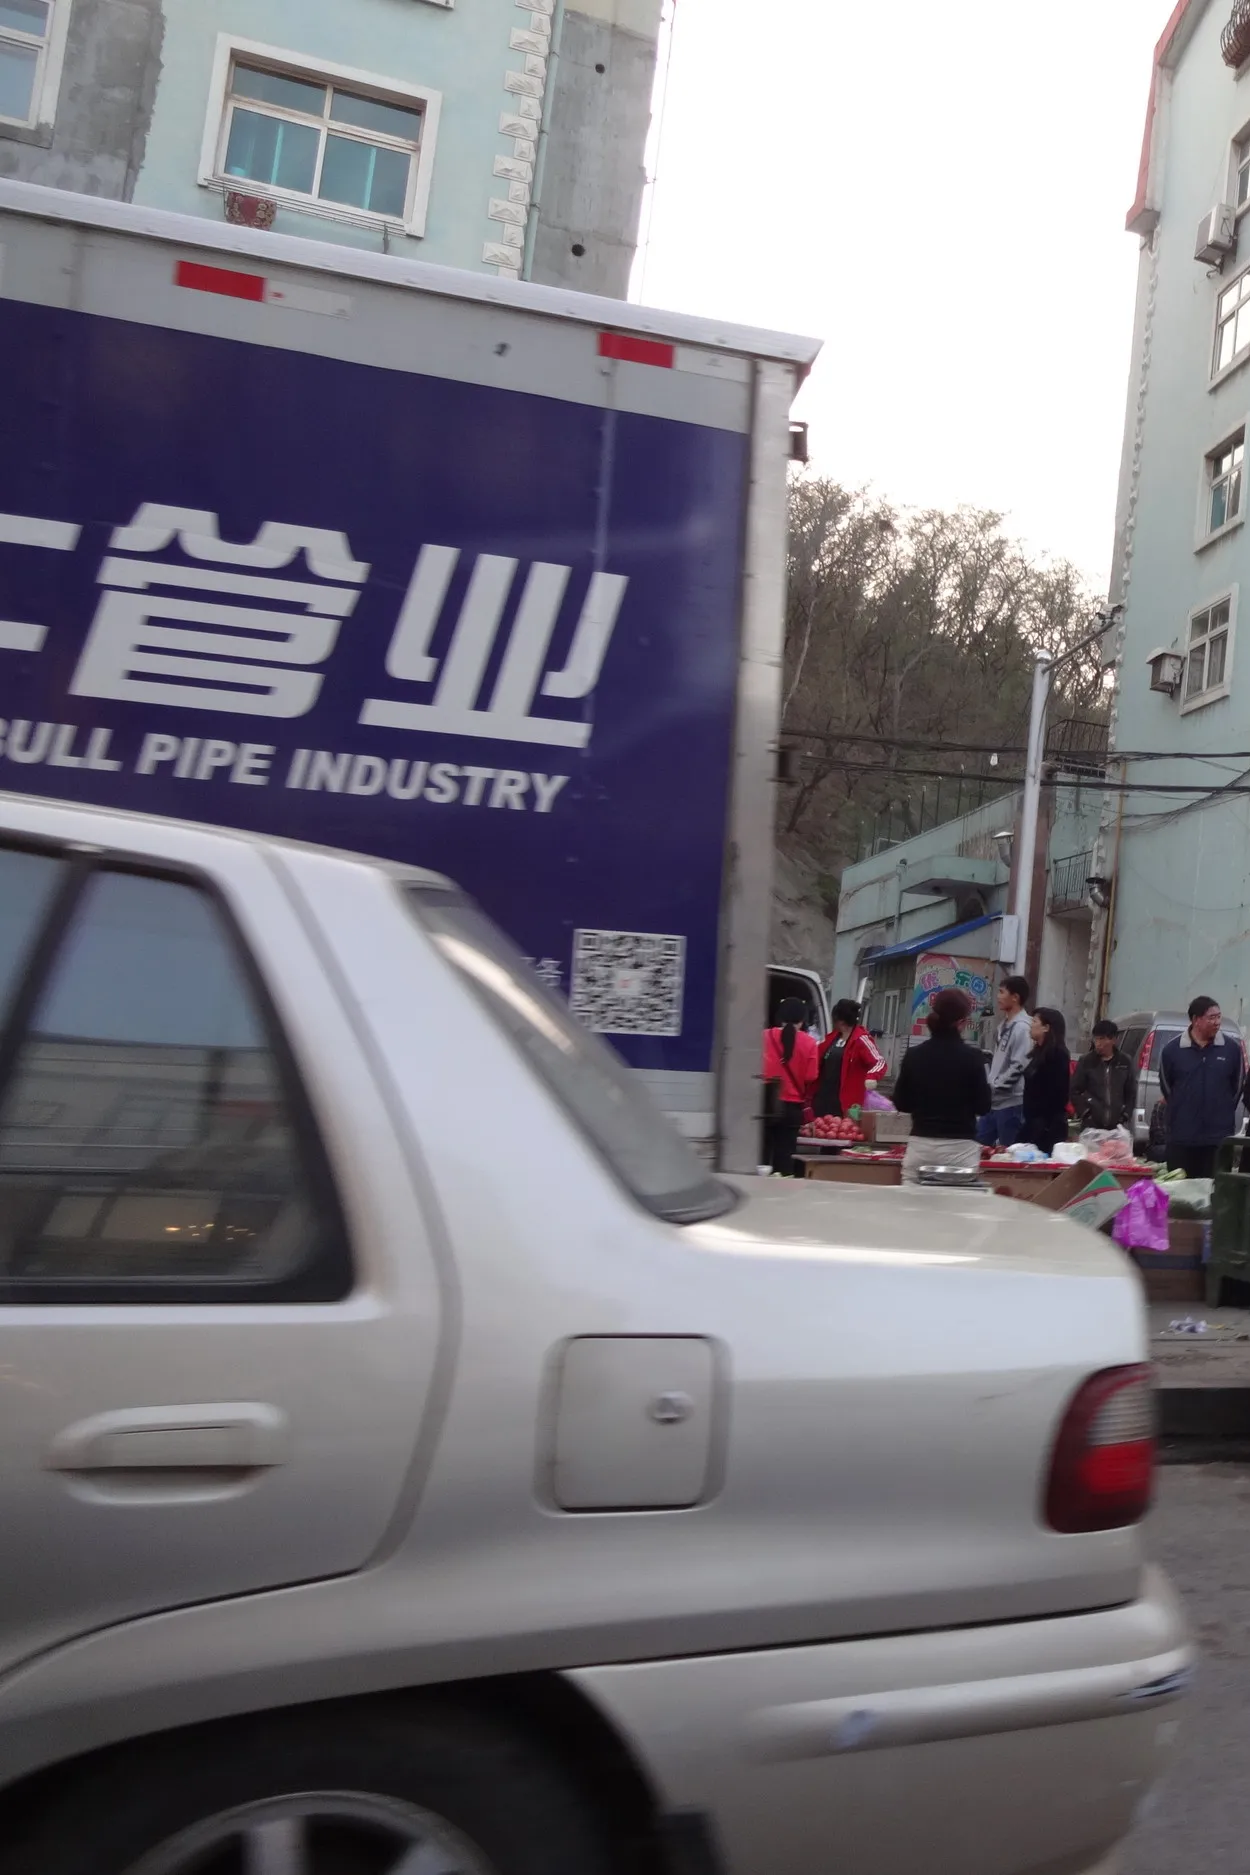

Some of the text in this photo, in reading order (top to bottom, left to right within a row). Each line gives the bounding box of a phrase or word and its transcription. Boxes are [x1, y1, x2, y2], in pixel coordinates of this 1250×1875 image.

[0, 502, 628, 748] 管业
[135, 733, 276, 786] PIPE
[286, 748, 570, 813] INDUSTRY
